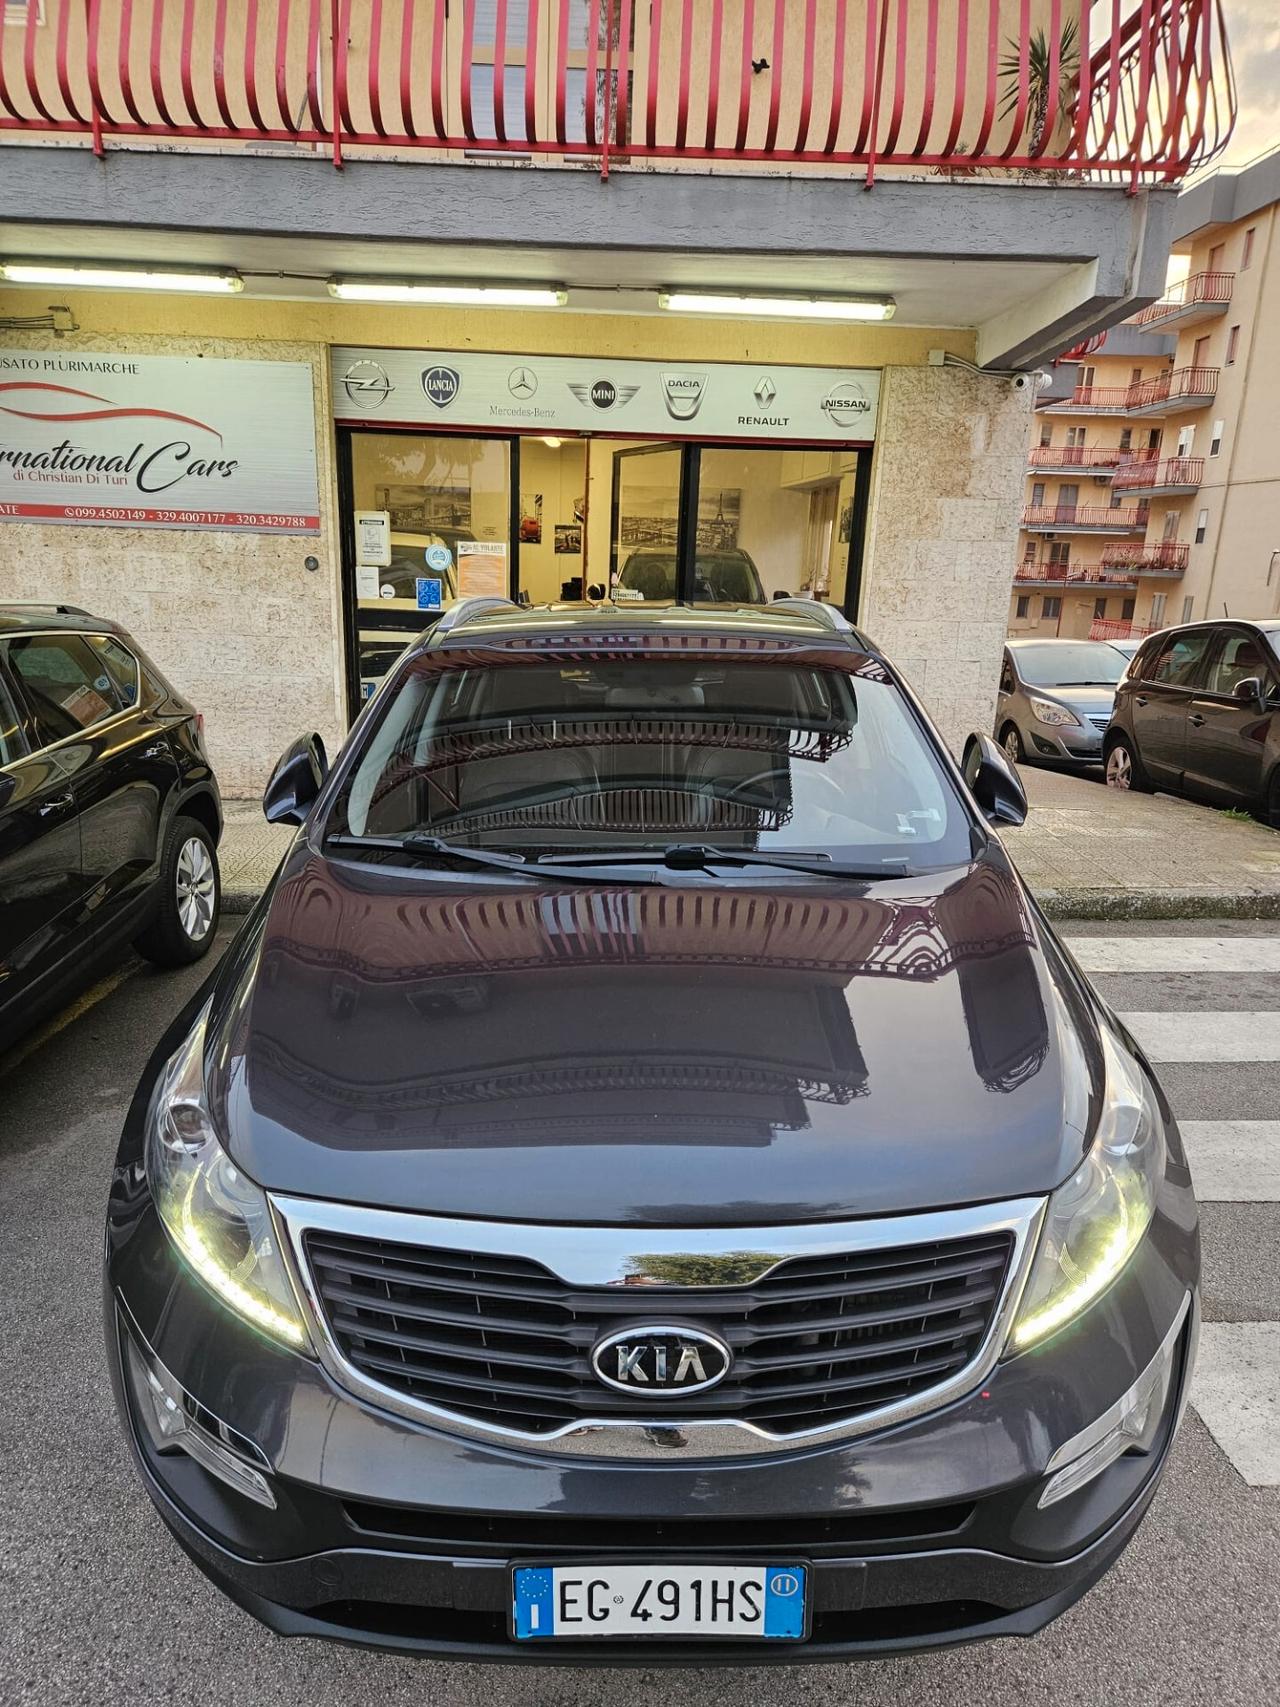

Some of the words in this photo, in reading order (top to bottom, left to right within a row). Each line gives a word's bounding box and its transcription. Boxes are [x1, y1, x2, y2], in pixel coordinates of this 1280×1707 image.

[44, 359, 140, 375] PLURIMARCHE
[428, 378, 454, 392] LANCIA
[667, 379, 700, 389] DACIA
[592, 388, 615, 400] MINI
[489, 405, 556, 418] Mercedes-Benz
[825, 399, 866, 409] NISSAN
[737, 415, 790, 426] RENAULT
[136, 441, 240, 493] Cars
[13, 469, 24, 481] di
[28, 470, 82, 485] Christian
[86, 472, 100, 485] Di
[102, 474, 128, 487] Turi
[75, 507, 146, 521] 099.4502149
[157, 510, 226, 524] 329.4007177
[236, 514, 306, 527] 320.3429788
[616, 1346, 707, 1381] KIA
[560, 1580, 610, 1622] EG
[630, 1580, 762, 1622] 491HS
